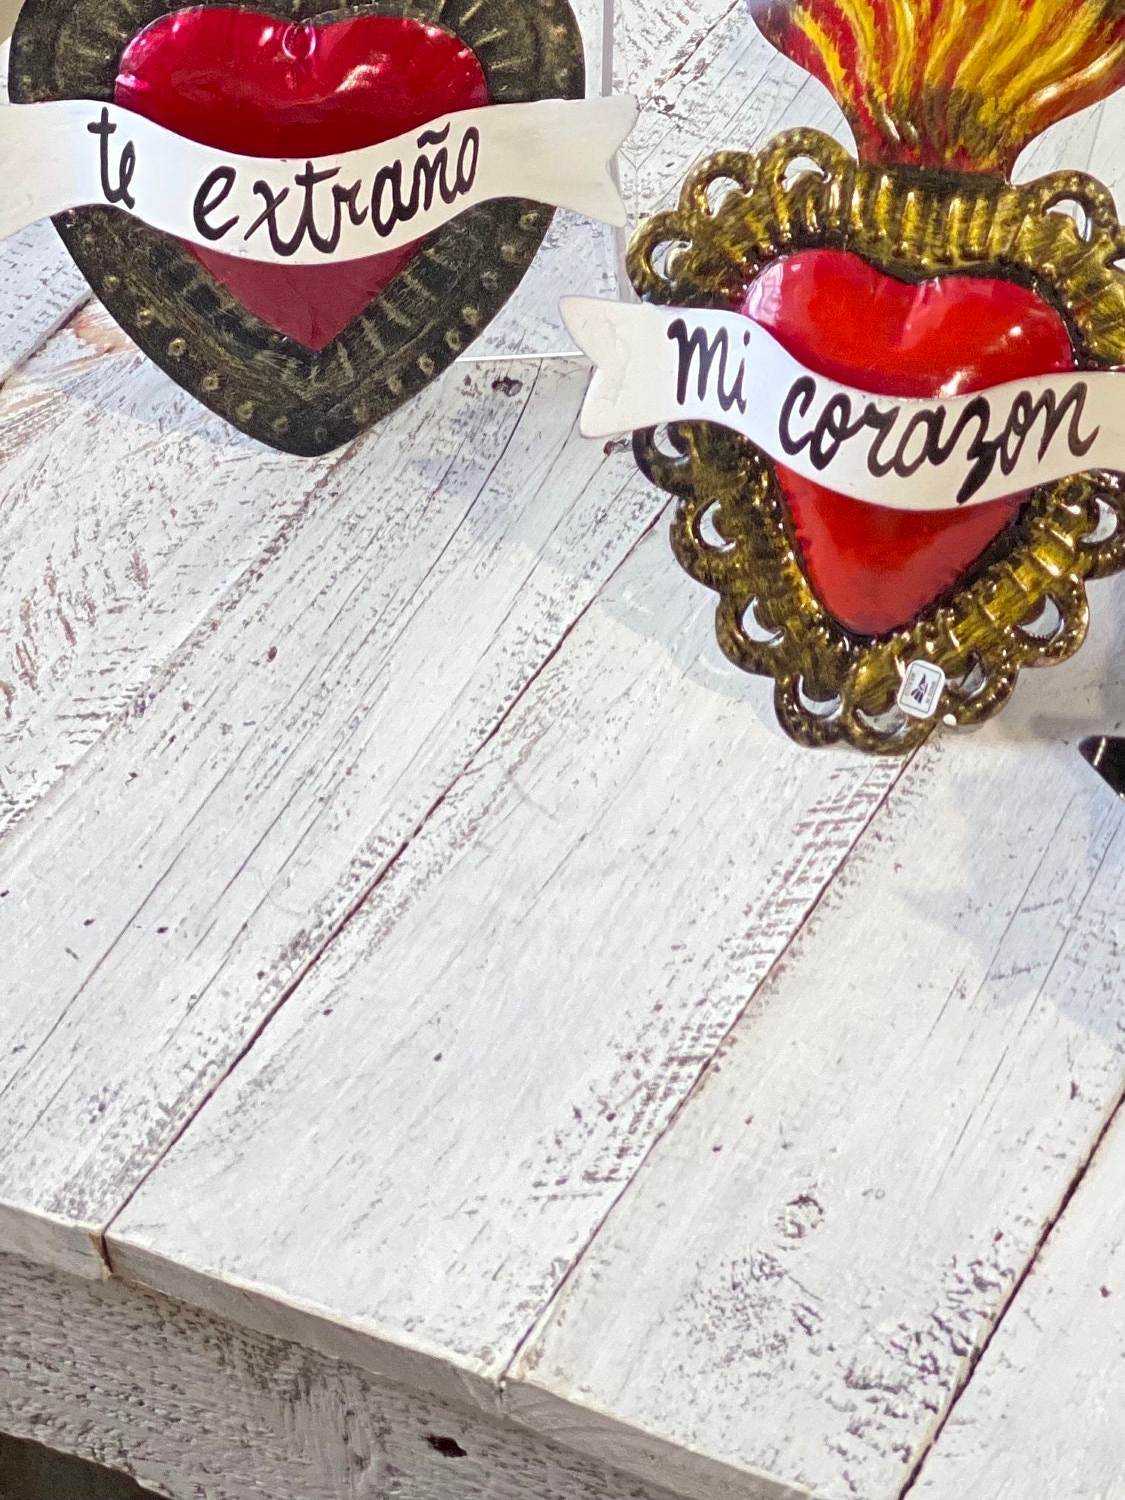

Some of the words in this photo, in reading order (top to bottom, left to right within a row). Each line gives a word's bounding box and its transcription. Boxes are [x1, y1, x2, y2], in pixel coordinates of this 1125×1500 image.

[87, 106, 136, 210] te
[193, 121, 480, 257] extraño
[778, 375, 1101, 504] corazon
